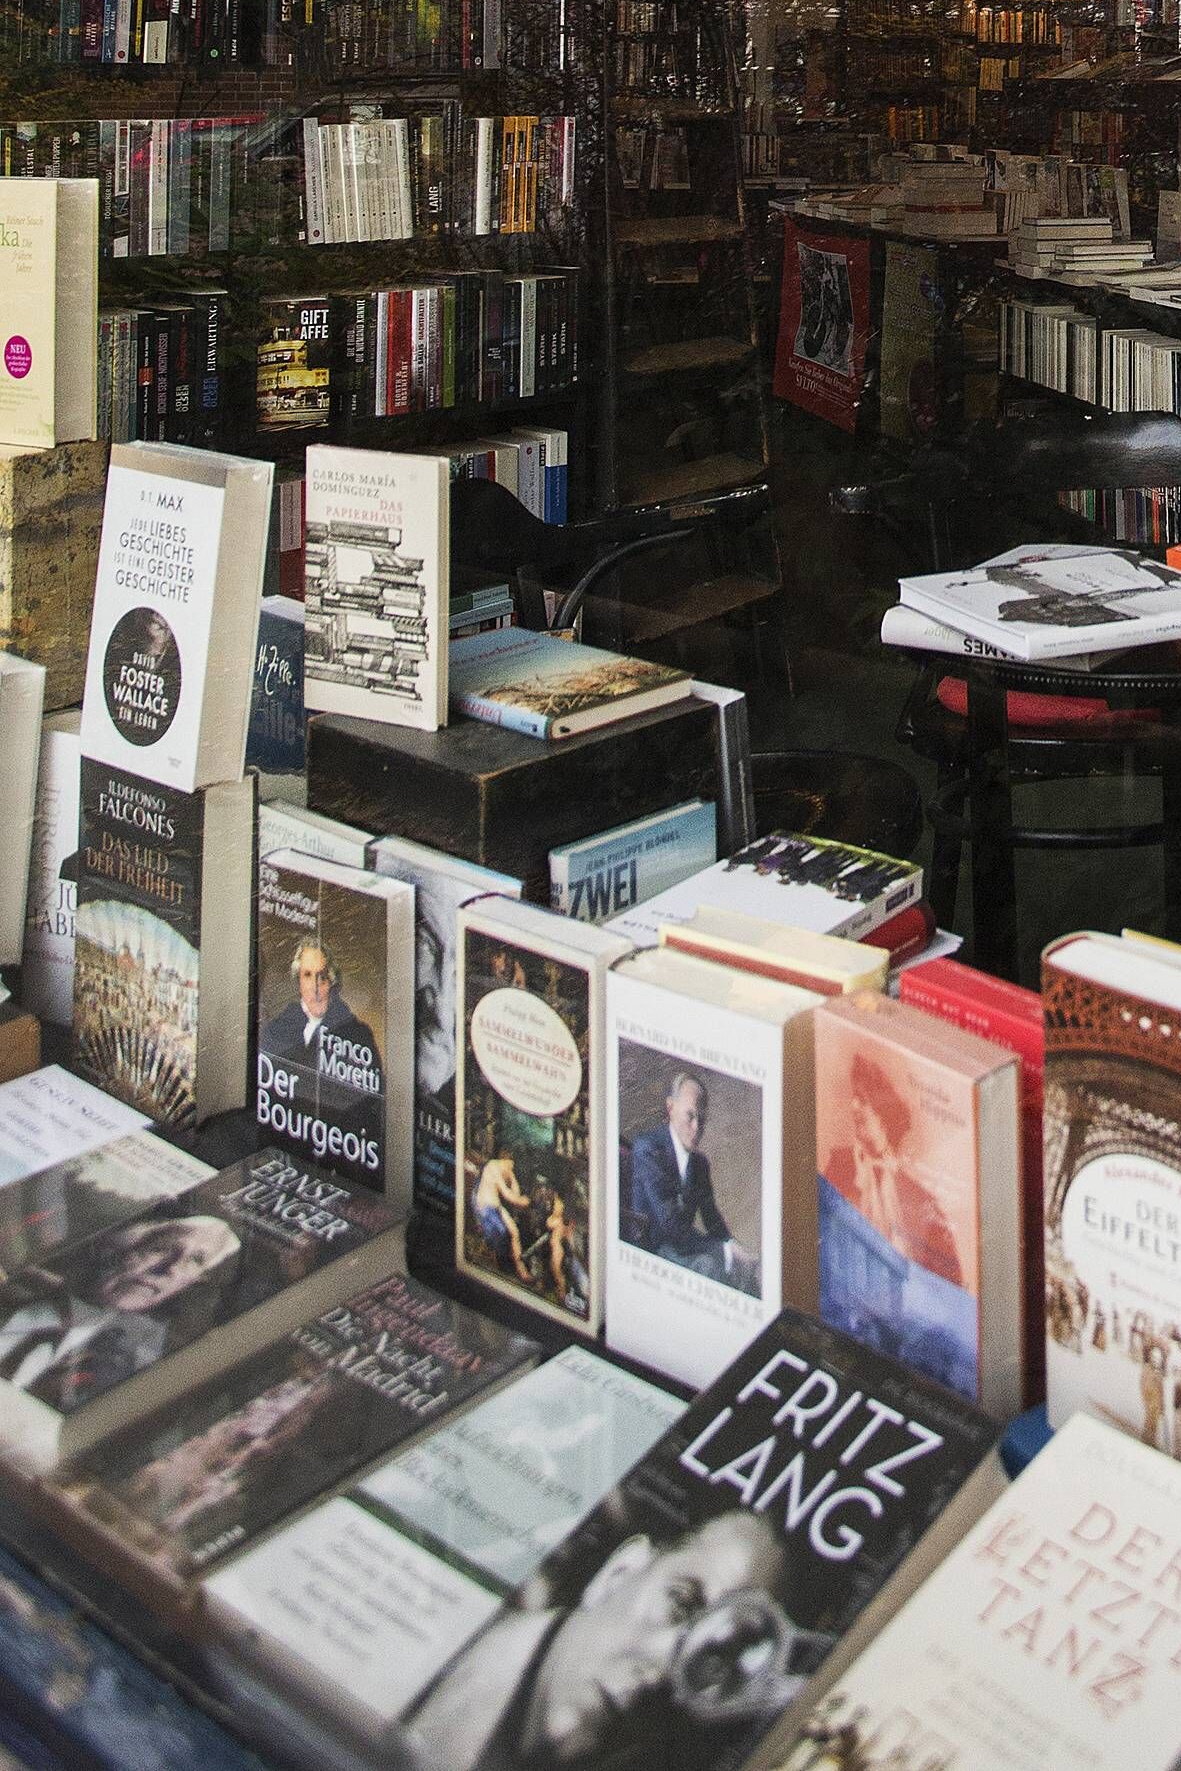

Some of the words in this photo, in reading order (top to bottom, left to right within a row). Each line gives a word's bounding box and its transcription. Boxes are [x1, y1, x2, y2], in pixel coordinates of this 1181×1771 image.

[429, 186, 438, 214] LANG
[300, 325, 328, 339] AFFE
[301, 309, 328, 325] GIFT
[10, 344, 26, 354] NEU
[207, 303, 218, 371] ERWARTUNG
[312, 469, 355, 484] CARLOS
[359, 473, 396, 488] MARÍA
[157, 495, 184, 512] MAX
[326, 506, 403, 525] PAPIERHAUS
[379, 500, 403, 513] DAS
[120, 533, 194, 565] GESCHICHTE
[150, 524, 186, 544] LIEBES
[115, 569, 189, 603] GESCHICHTE
[148, 559, 194, 585] GEISTER
[120, 666, 164, 695] FOSTER
[113, 682, 168, 717] WALLACE
[109, 780, 165, 813] ILDEFONSO
[100, 793, 175, 839] FALCONES
[570, 859, 637, 920] ZWEI
[319, 1025, 372, 1067] Franco
[257, 1054, 299, 1098] Der
[318, 1050, 380, 1092] Moretti
[256, 1087, 380, 1170] Bourgeois
[251, 1160, 352, 1210] ERNST
[1136, 1199, 1178, 1229] DER
[736, 1349, 944, 1498] FRITZ
[679, 1406, 884, 1562] LANG
[977, 1577, 1149, 1722] TANZ
